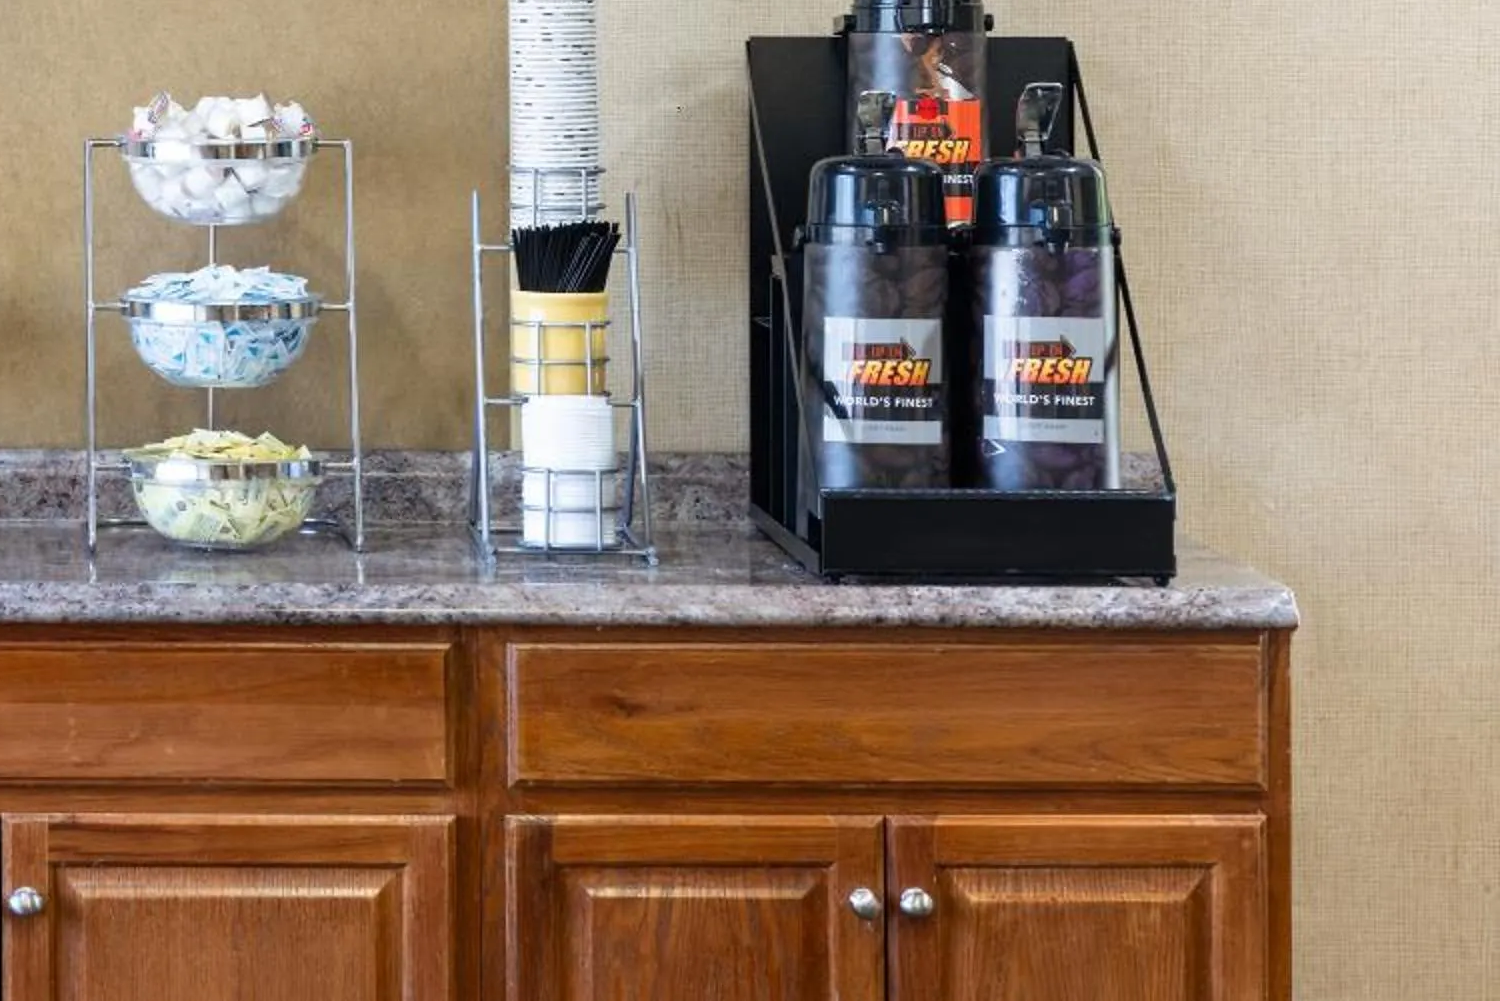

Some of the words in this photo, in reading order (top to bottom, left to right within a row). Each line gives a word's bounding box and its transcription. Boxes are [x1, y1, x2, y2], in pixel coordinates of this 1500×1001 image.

[942, 174, 974, 184] INEST
[847, 359, 931, 387] FRESH
[1004, 357, 1092, 385] FRESH
[833, 395, 891, 408] WORLD'S
[895, 396, 933, 408] FINEST
[1054, 395, 1096, 407] FINEST
